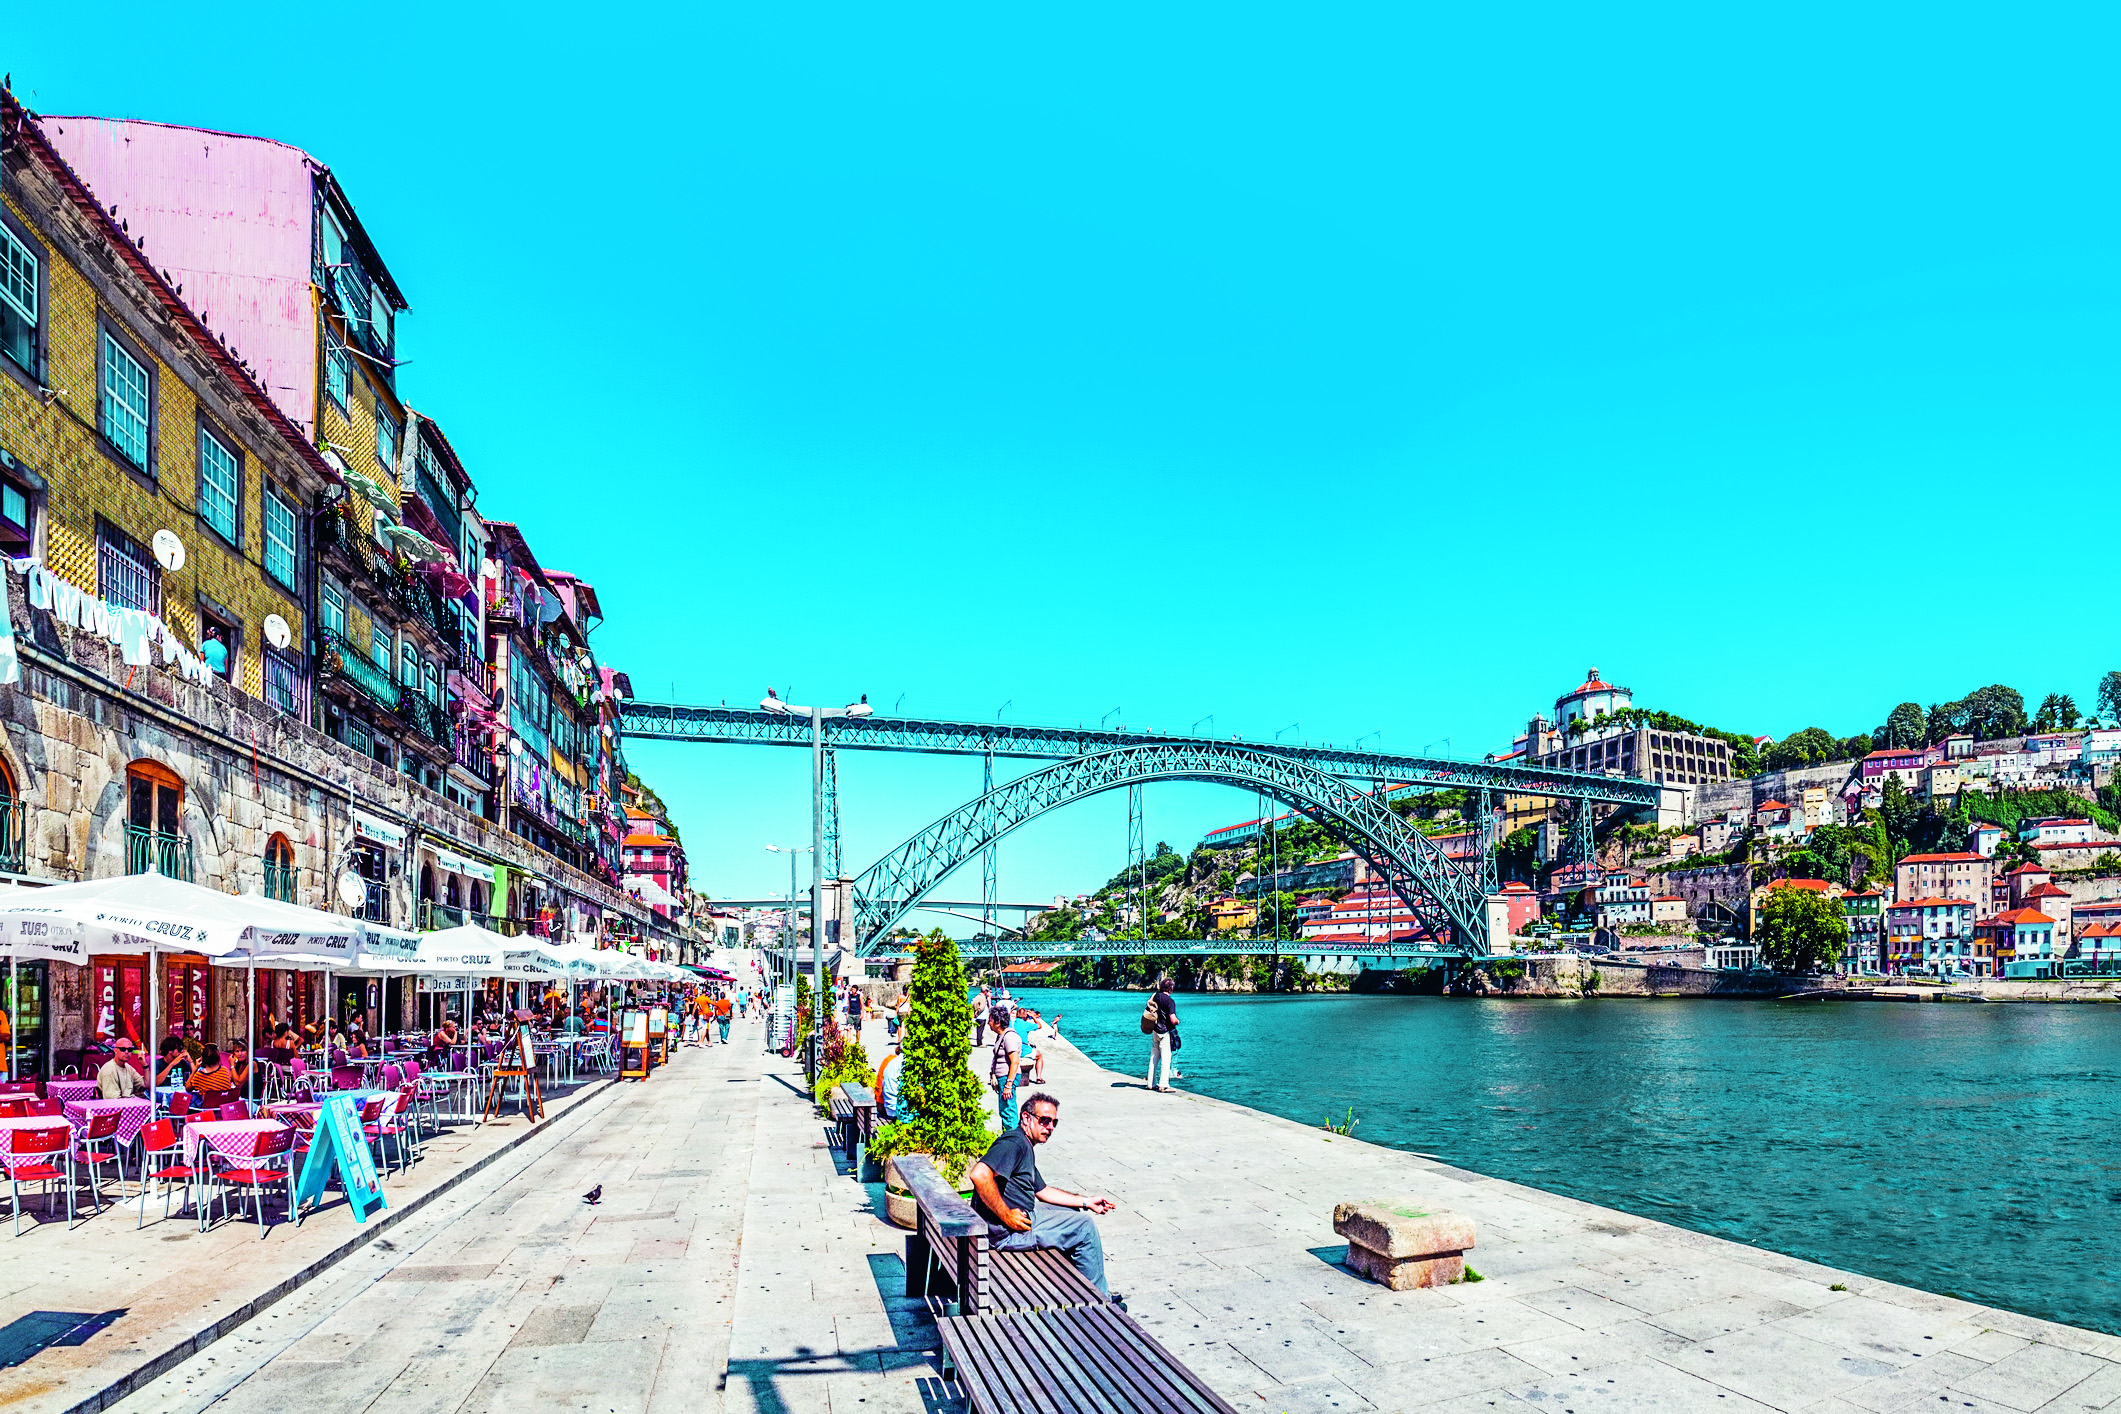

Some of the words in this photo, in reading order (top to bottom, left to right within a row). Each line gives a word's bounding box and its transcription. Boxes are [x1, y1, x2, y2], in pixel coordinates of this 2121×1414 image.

[108, 915, 143, 927] PORTO
[145, 920, 194, 941] CRUZ
[272, 933, 300, 945] CRUZ
[307, 936, 325, 945] PORTO
[326, 935, 349, 949] CRUZ
[365, 931, 381, 945] RUZ
[400, 937, 418, 951] CRUZ
[461, 955, 492, 965] CRUZ
